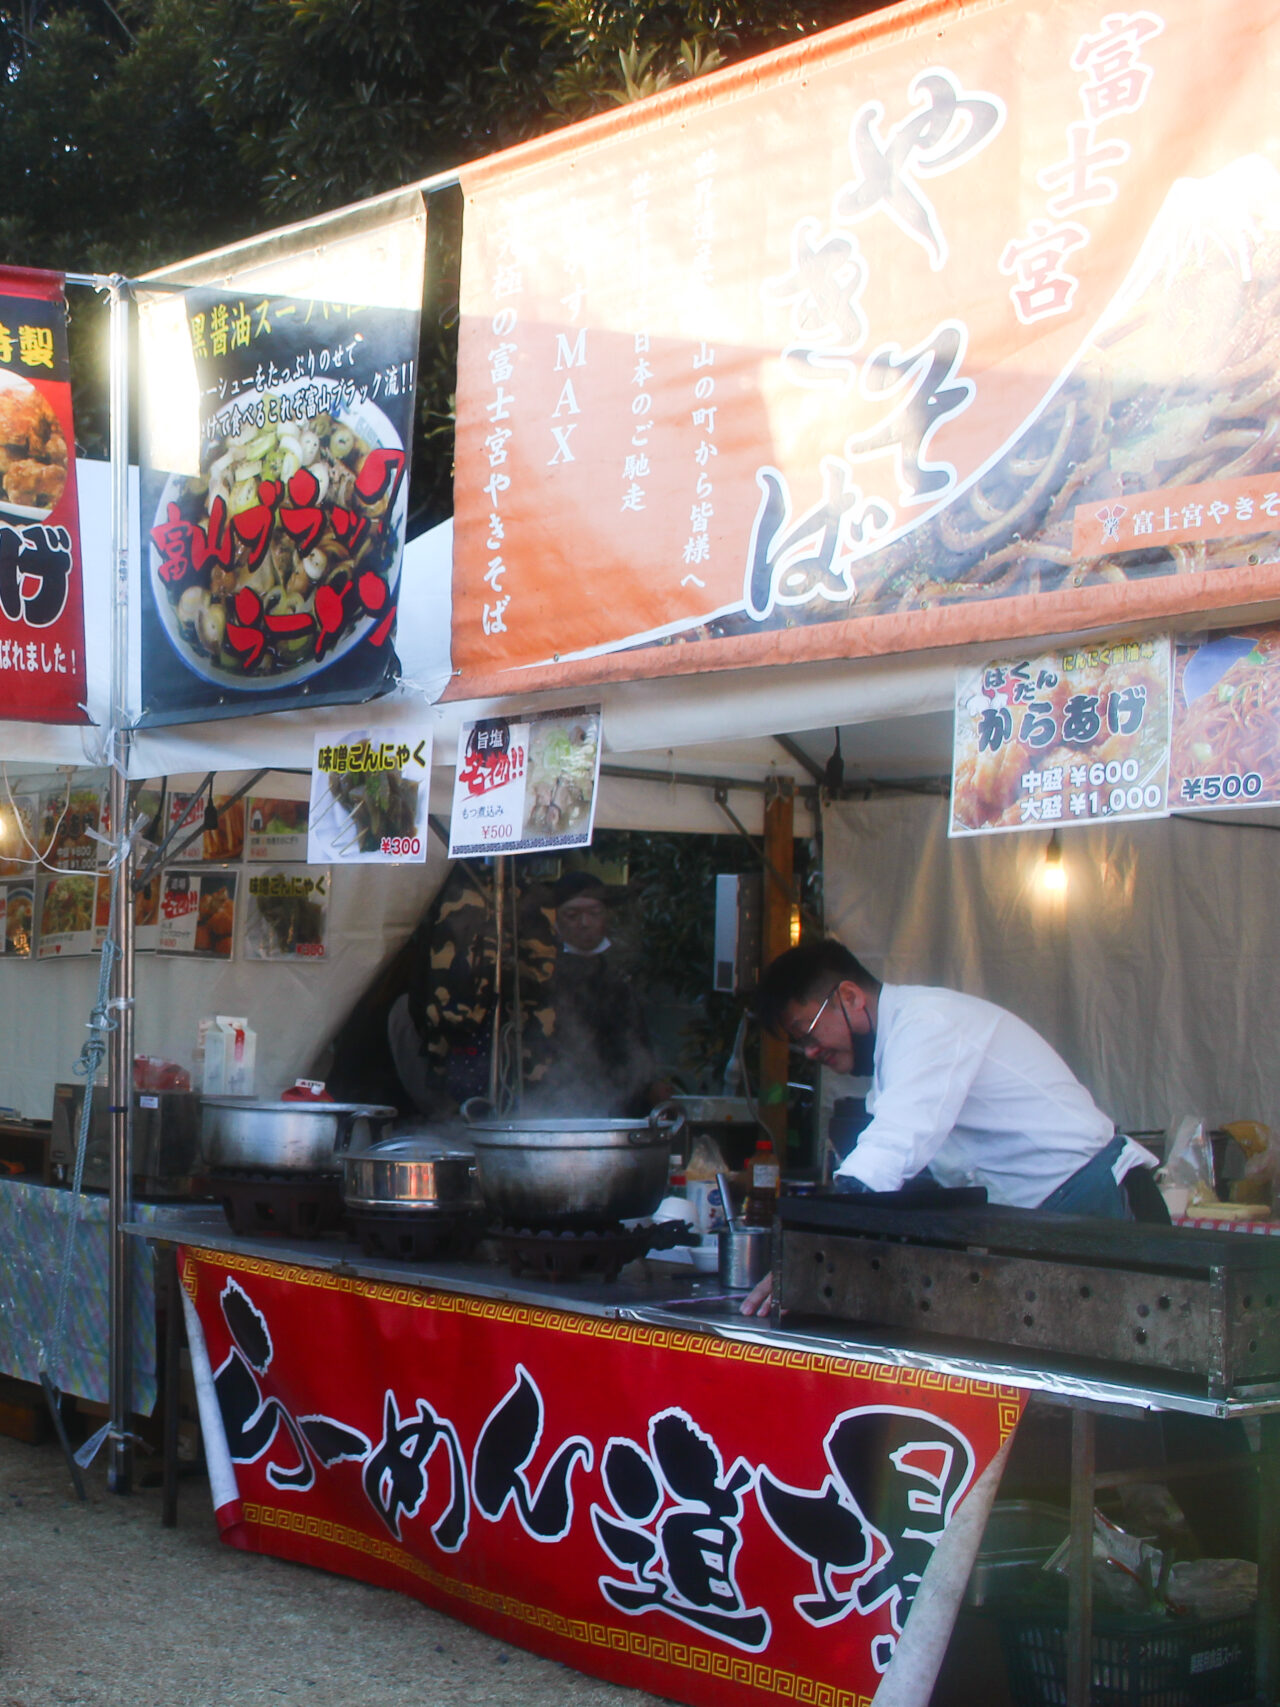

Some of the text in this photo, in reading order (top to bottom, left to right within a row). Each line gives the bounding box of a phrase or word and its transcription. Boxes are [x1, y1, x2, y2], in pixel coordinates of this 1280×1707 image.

[999, 11, 1164, 325] 富士宮
[745, 68, 1006, 621] やきそば
[201, 361, 415, 440] けて食べるこれぞ富山ブラック流!!
[226, 571, 397, 669] ラーメン
[1062, 643, 1156, 672] にんにく醤油味
[978, 685, 1147, 753] からあげ
[318, 739, 426, 774] 味噌こんにゃく
[477, 729, 503, 750] 旨塩
[1021, 759, 1139, 794] 中盛 ¥600
[1182, 772, 1262, 802] ¥500
[1021, 784, 1162, 822] 大盛 ¥1,000
[381, 836, 420, 856] ¥300
[481, 824, 513, 839] ¥500
